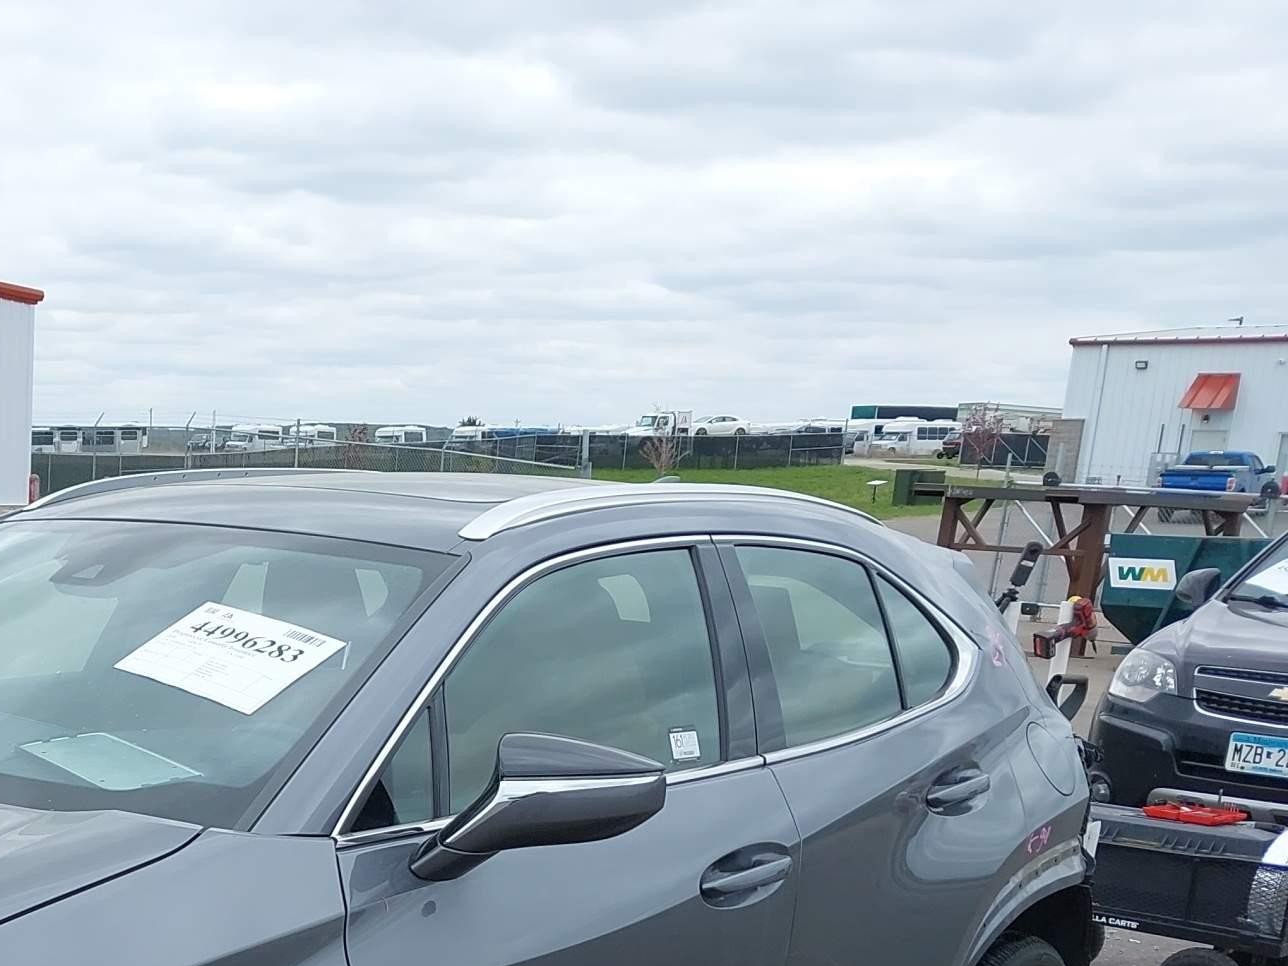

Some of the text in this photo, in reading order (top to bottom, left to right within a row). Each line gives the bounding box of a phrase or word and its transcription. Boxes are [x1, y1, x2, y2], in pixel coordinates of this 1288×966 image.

[1118, 566, 1169, 582] WM
[189, 621, 305, 663] 44996283
[1231, 743, 1288, 768] MZB 2
